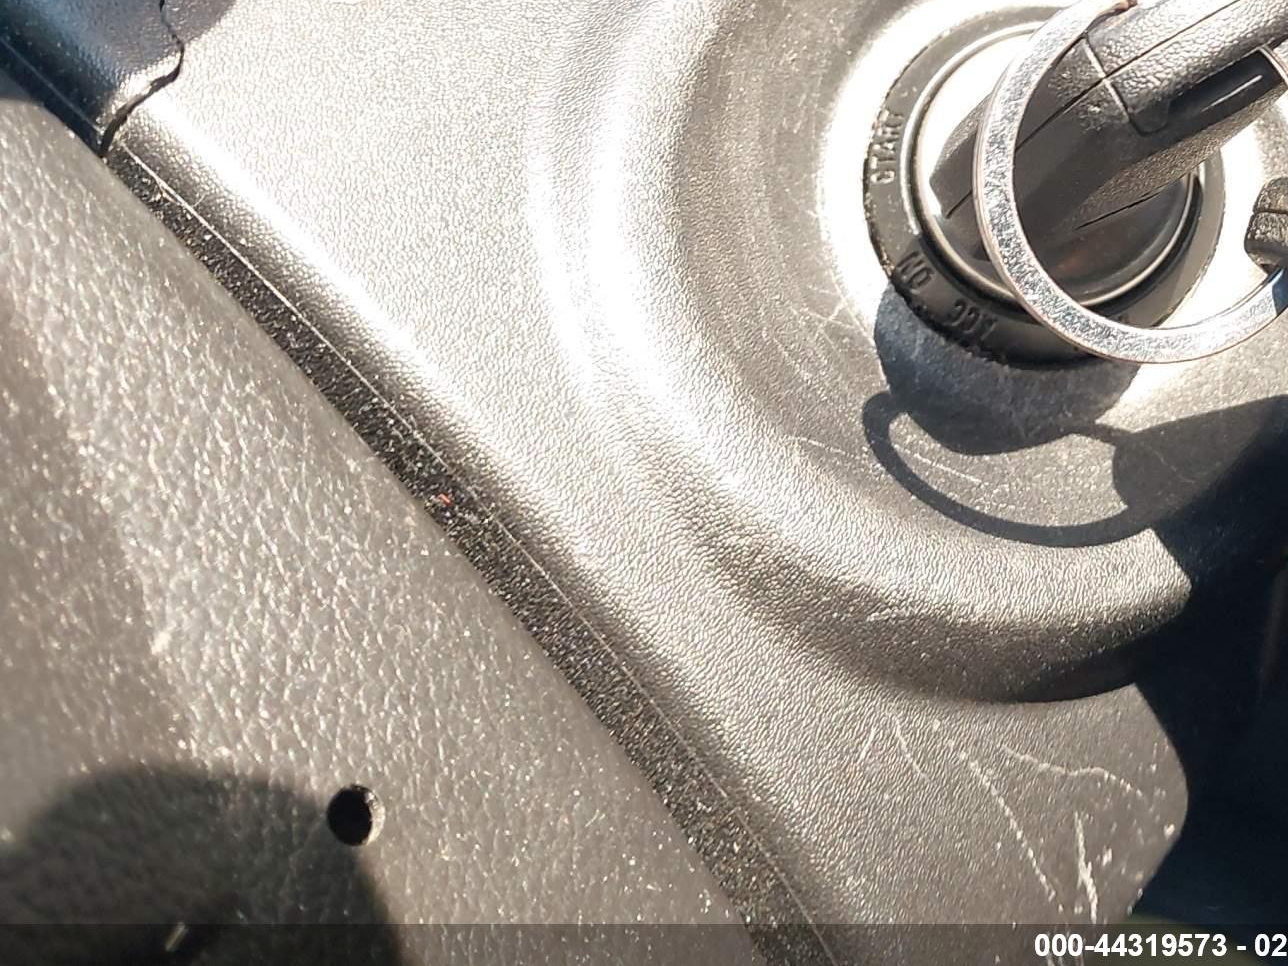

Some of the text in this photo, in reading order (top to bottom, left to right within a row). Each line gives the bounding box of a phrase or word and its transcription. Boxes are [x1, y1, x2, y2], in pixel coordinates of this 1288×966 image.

[869, 112, 904, 184] START
[895, 251, 934, 294] ON
[948, 297, 999, 341] ACC
